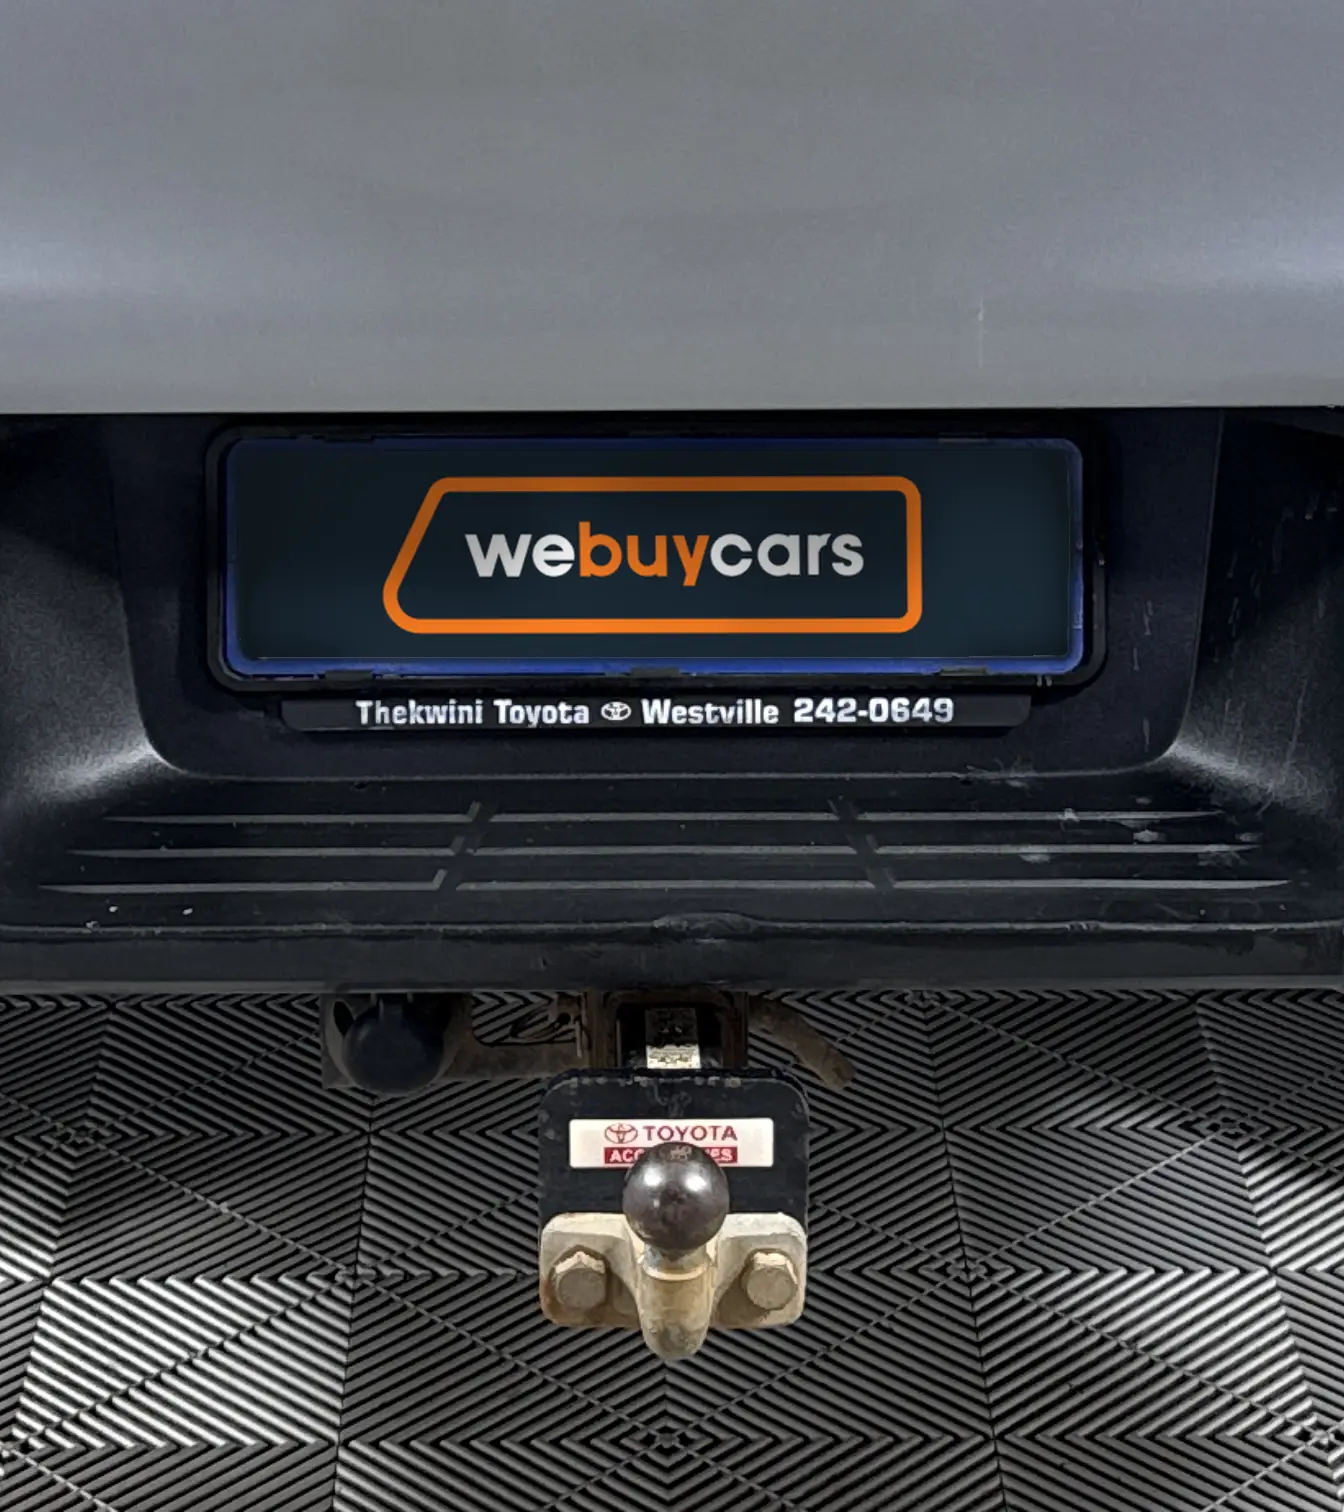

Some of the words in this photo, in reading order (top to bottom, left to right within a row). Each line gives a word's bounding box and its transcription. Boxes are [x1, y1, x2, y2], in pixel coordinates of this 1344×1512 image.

[356, 700, 483, 724] Thekwini
[494, 701, 590, 727] Toyota
[641, 699, 779, 724] Westville
[794, 698, 954, 724] 242-0649
[643, 1125, 738, 1142] TOYOTA
